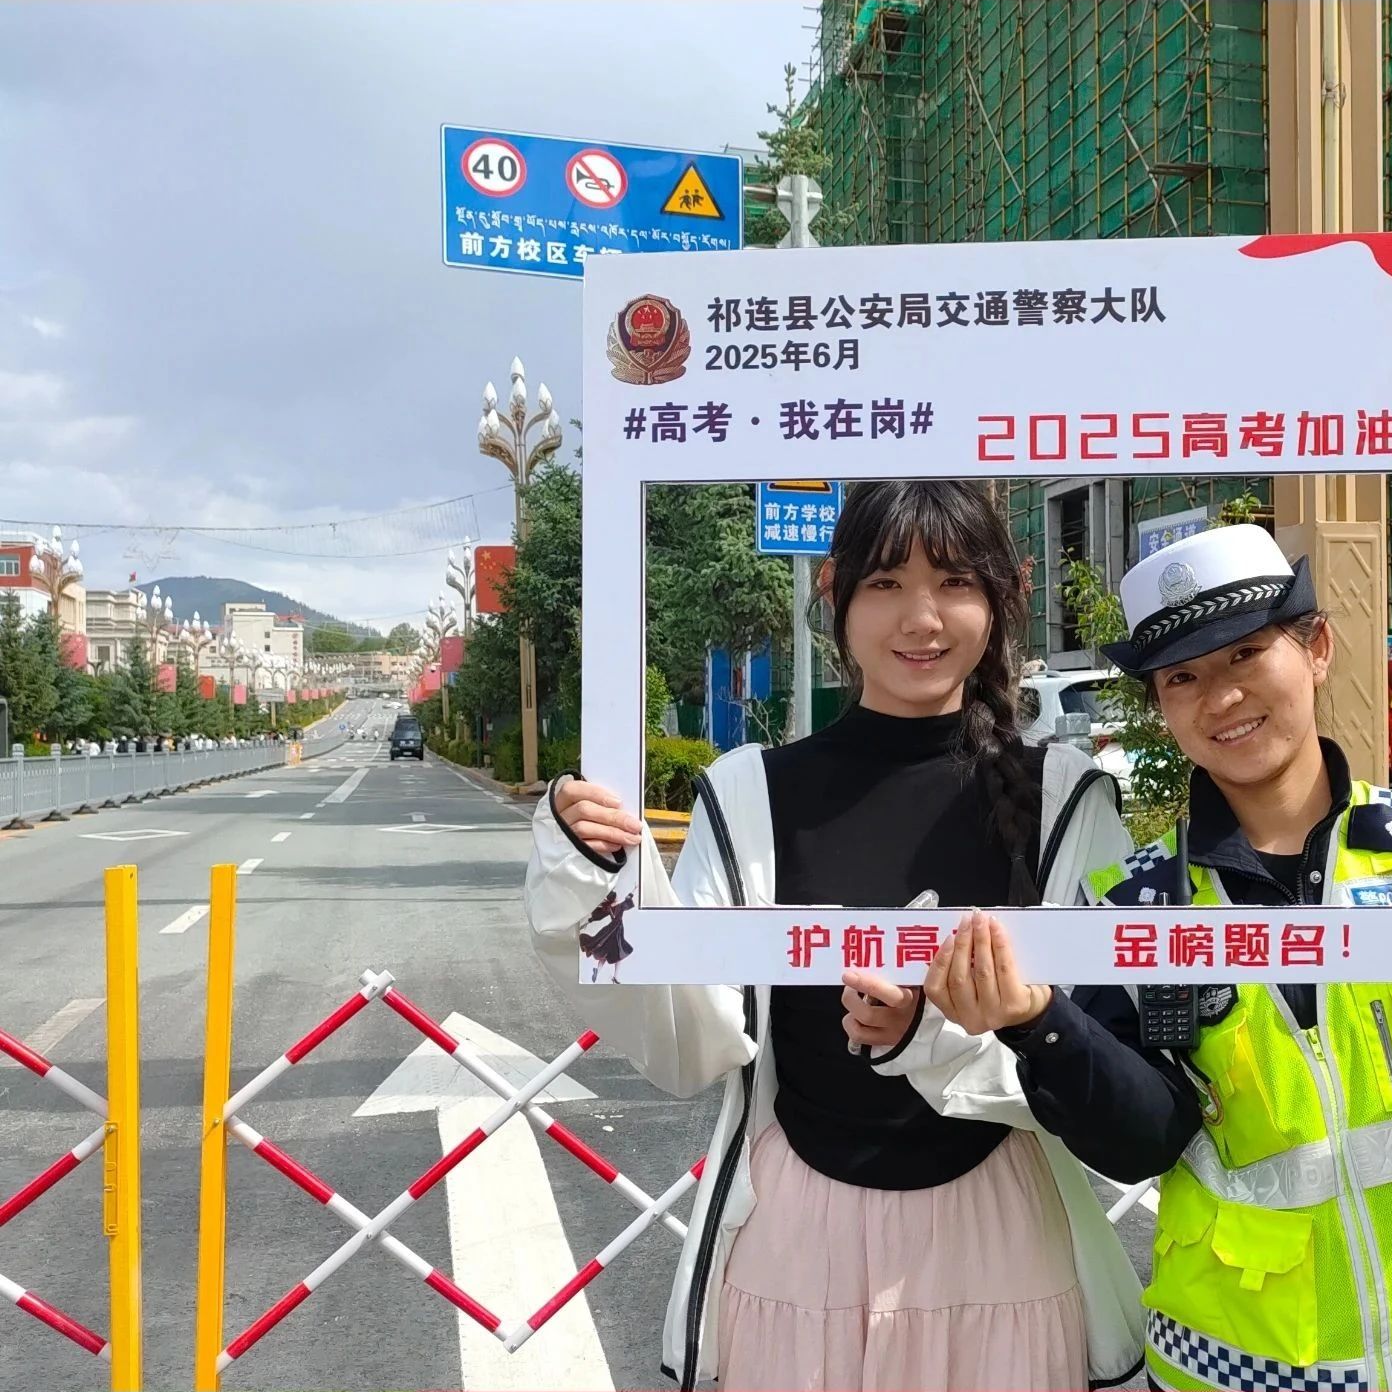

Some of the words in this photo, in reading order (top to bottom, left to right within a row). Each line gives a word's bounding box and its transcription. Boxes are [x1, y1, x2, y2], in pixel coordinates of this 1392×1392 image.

[471, 154, 518, 181] 40
[706, 287, 1166, 334] 祁连县公安局交通警察大队
[705, 339, 862, 373] 2025年6月
[623, 397, 935, 444] #高考·我在岗#
[764, 502, 836, 522] 前方学校
[763, 523, 835, 543] 减速慢行
[786, 923, 974, 970] 护航高
[1113, 922, 1352, 969] 金榜题名！
